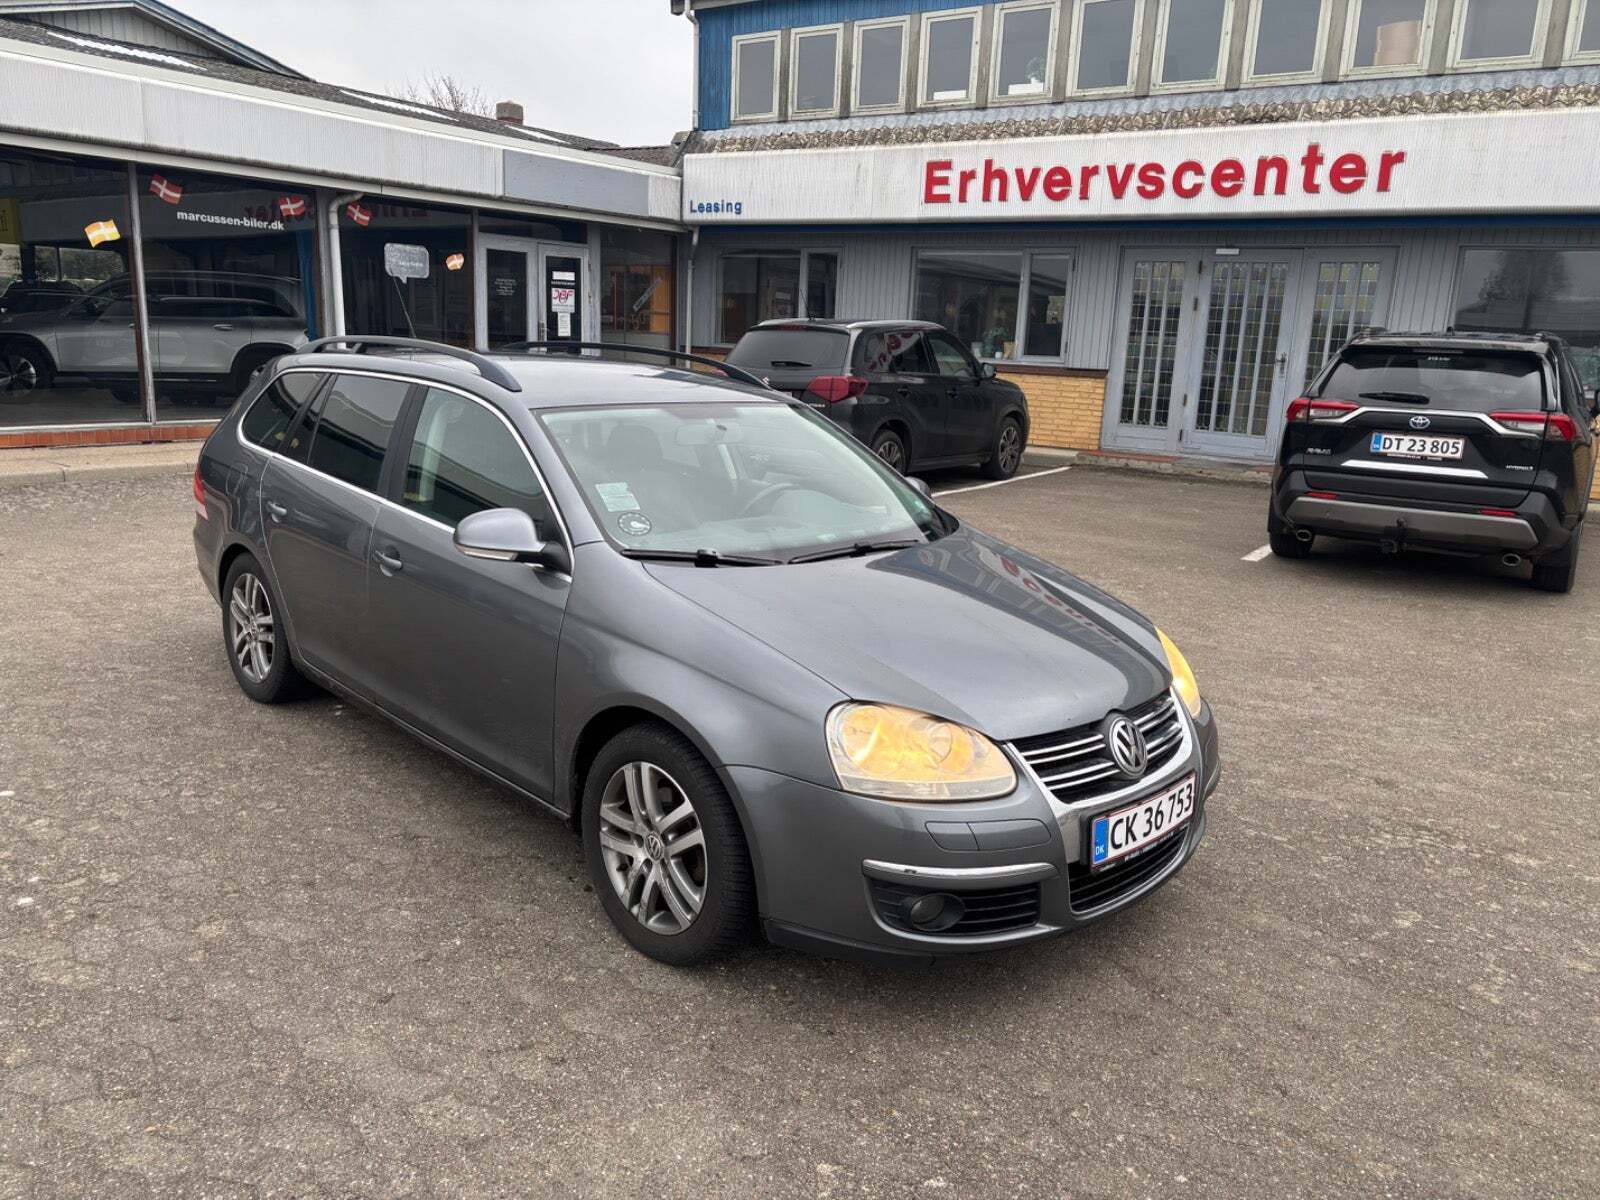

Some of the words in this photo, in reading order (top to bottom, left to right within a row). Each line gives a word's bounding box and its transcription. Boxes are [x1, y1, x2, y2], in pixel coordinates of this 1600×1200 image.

[924, 142, 1405, 203] Erhvervscenter
[690, 199, 742, 215] Leasing
[176, 211, 285, 231] marcussen-biler.dk
[1382, 437, 1404, 451] DT
[1406, 438, 1427, 453] 23
[1430, 440, 1461, 455] 805
[1110, 812, 1138, 850] CK
[1142, 800, 1165, 838] 36
[1167, 783, 1193, 824] 753
[1095, 844, 1105, 856] DK
